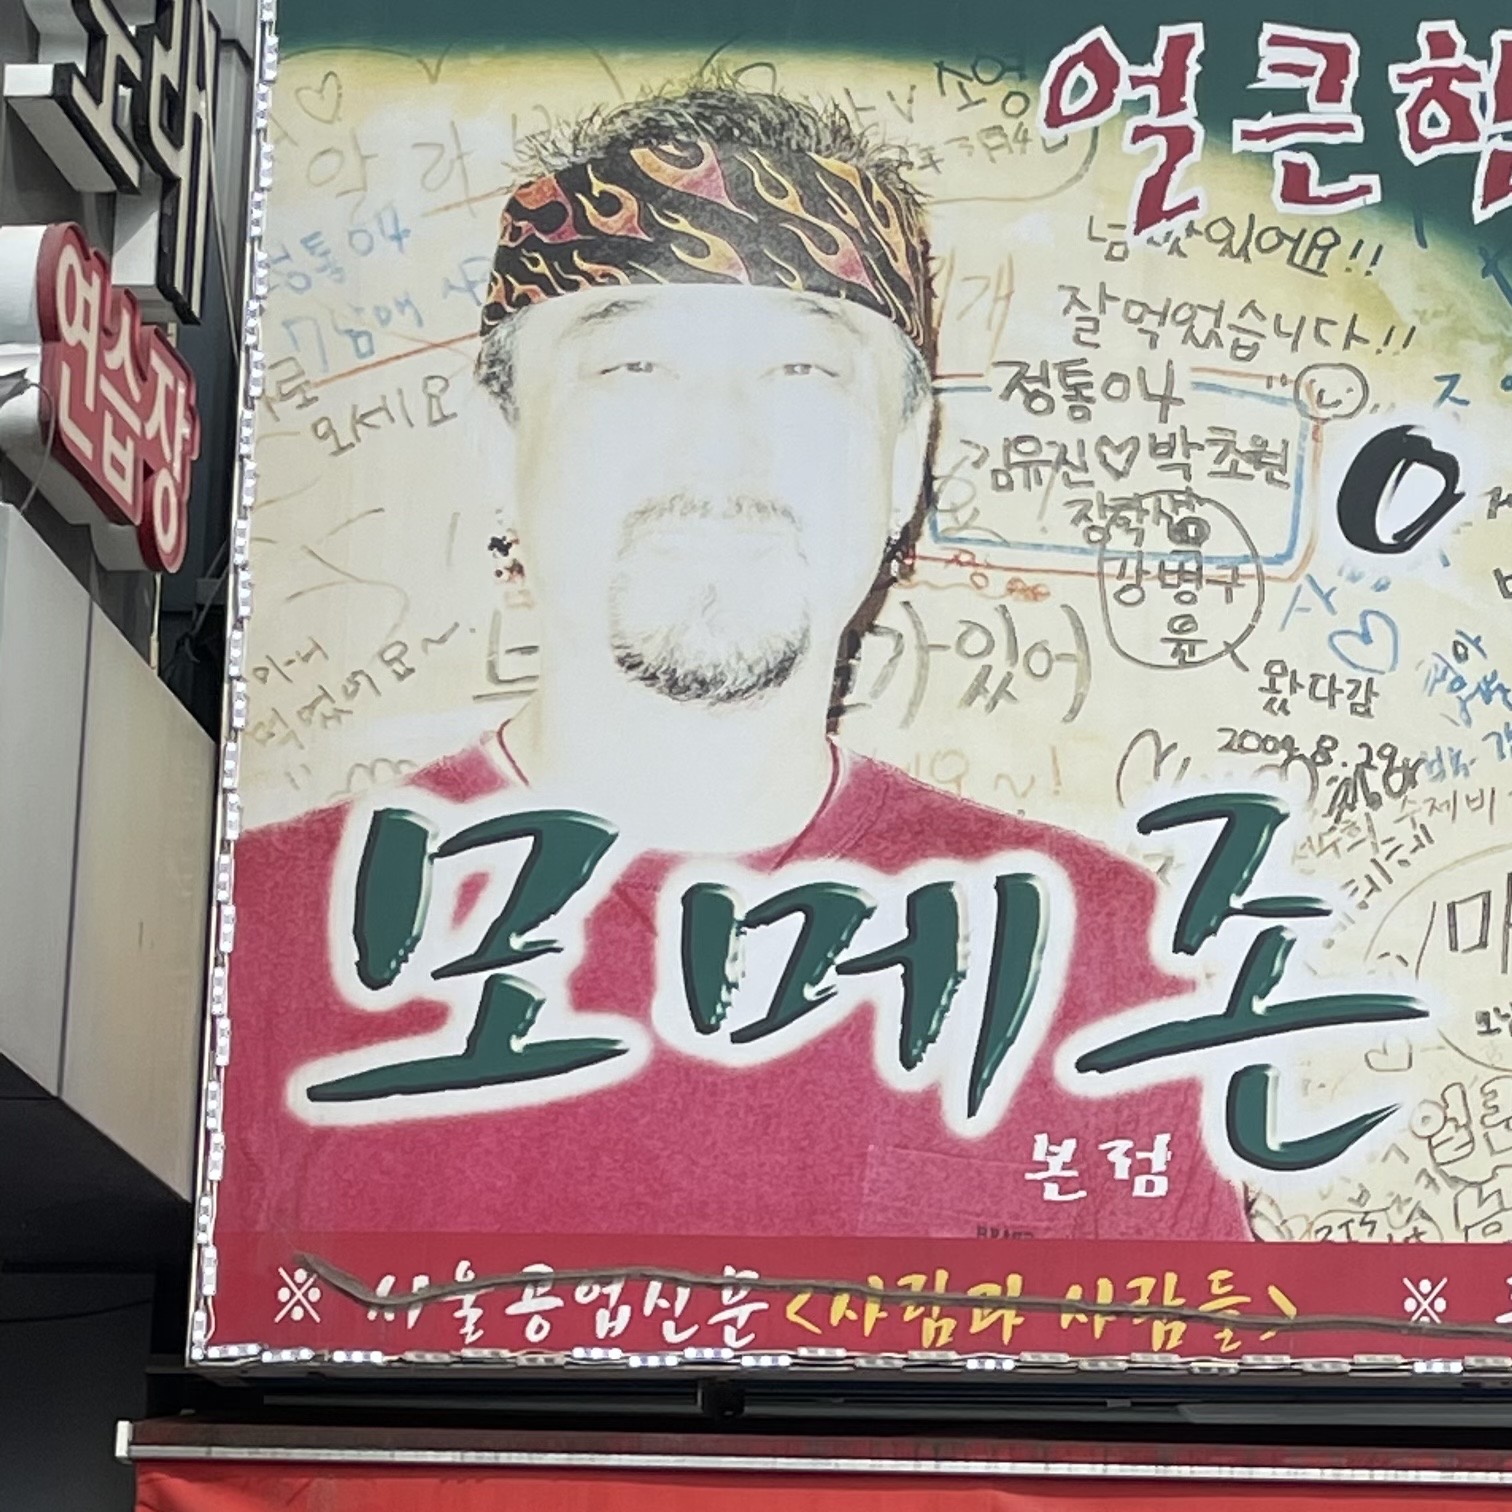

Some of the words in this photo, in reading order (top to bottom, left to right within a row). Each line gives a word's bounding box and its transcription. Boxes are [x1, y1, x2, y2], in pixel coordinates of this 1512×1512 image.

[55, 243, 190, 552] 연습장
[305, 793, 1430, 1172] 모메존
[1024, 1132, 1172, 1201] 본점
